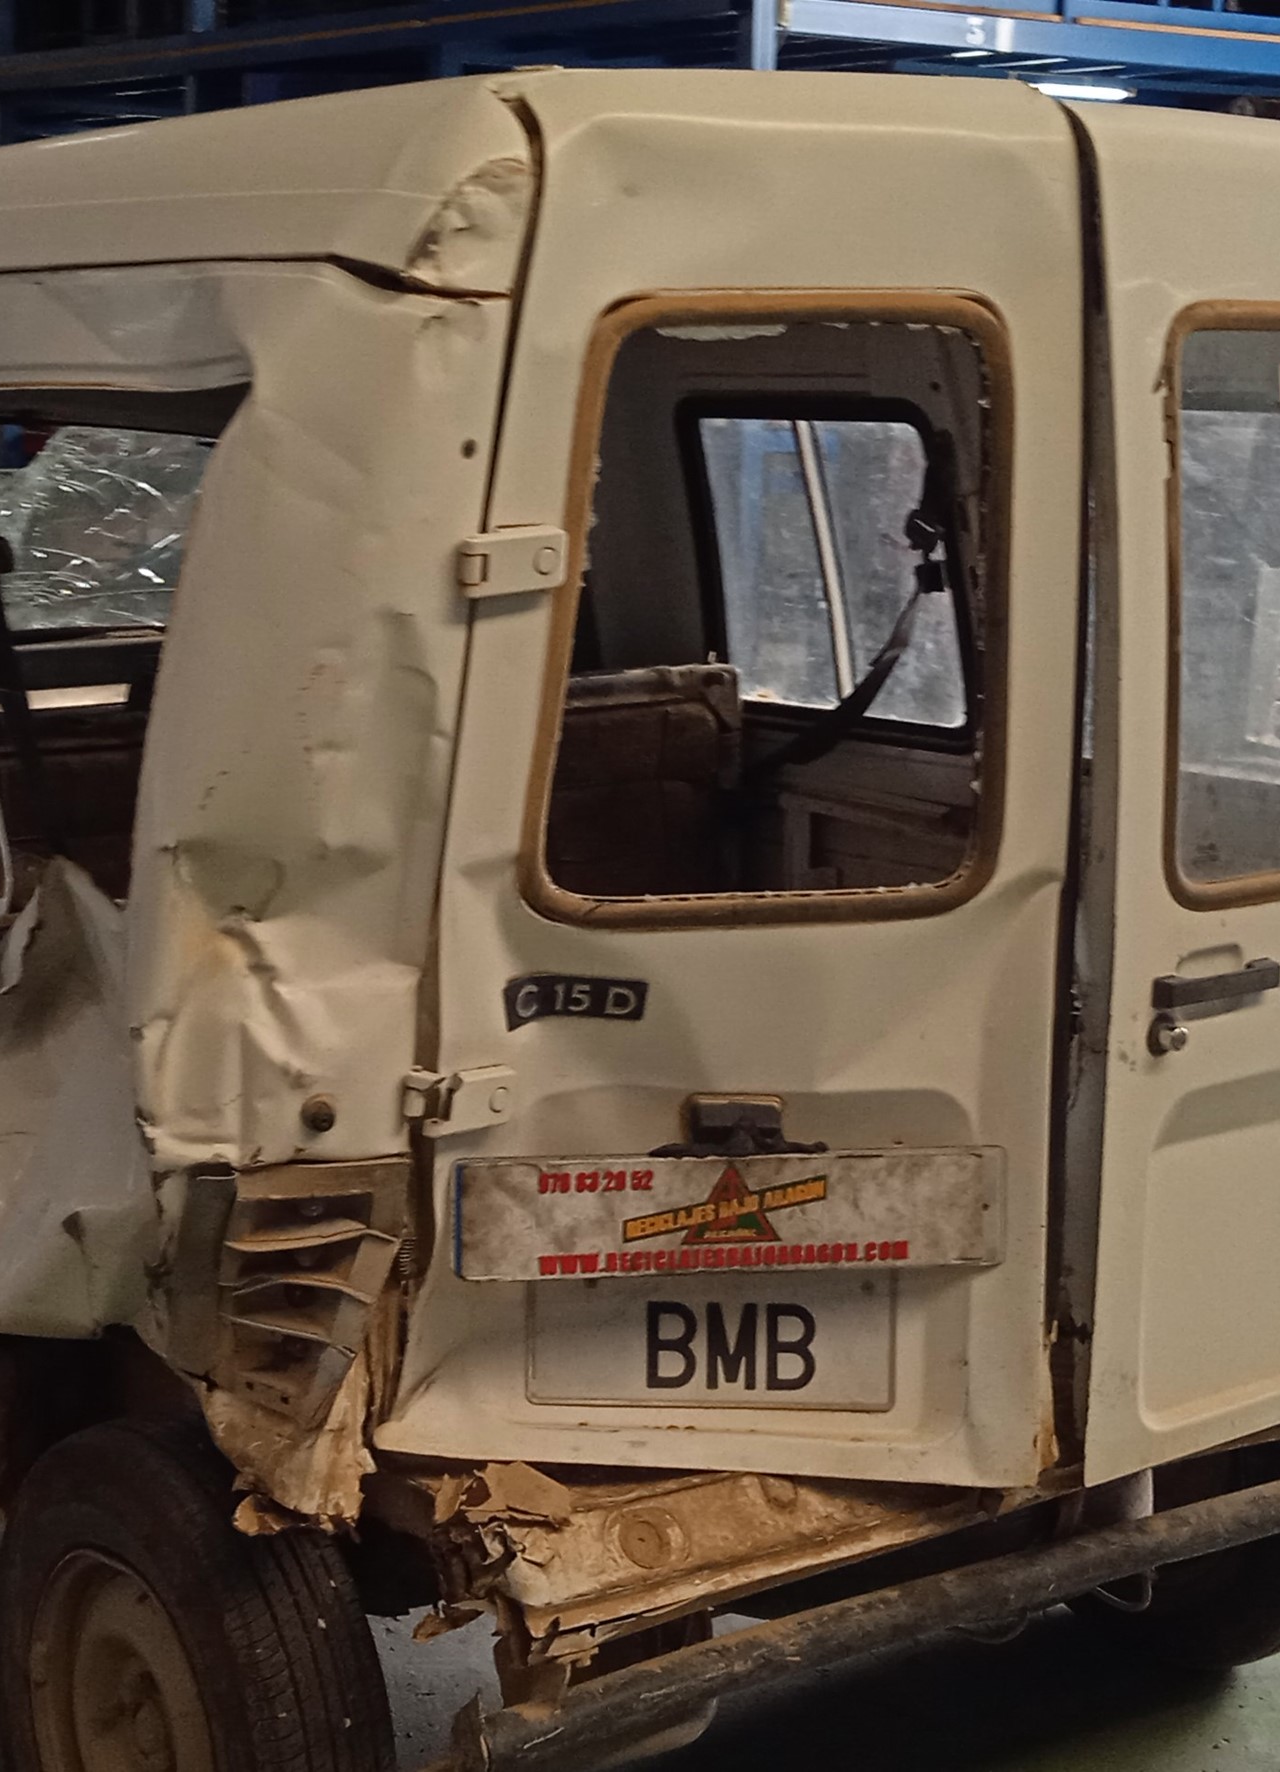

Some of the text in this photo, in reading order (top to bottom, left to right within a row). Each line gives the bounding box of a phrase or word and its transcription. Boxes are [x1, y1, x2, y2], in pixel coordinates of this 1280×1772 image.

[516, 983, 636, 1018] C 15 D
[631, 1168, 654, 1191] 52
[646, 1300, 816, 1391] BMB
